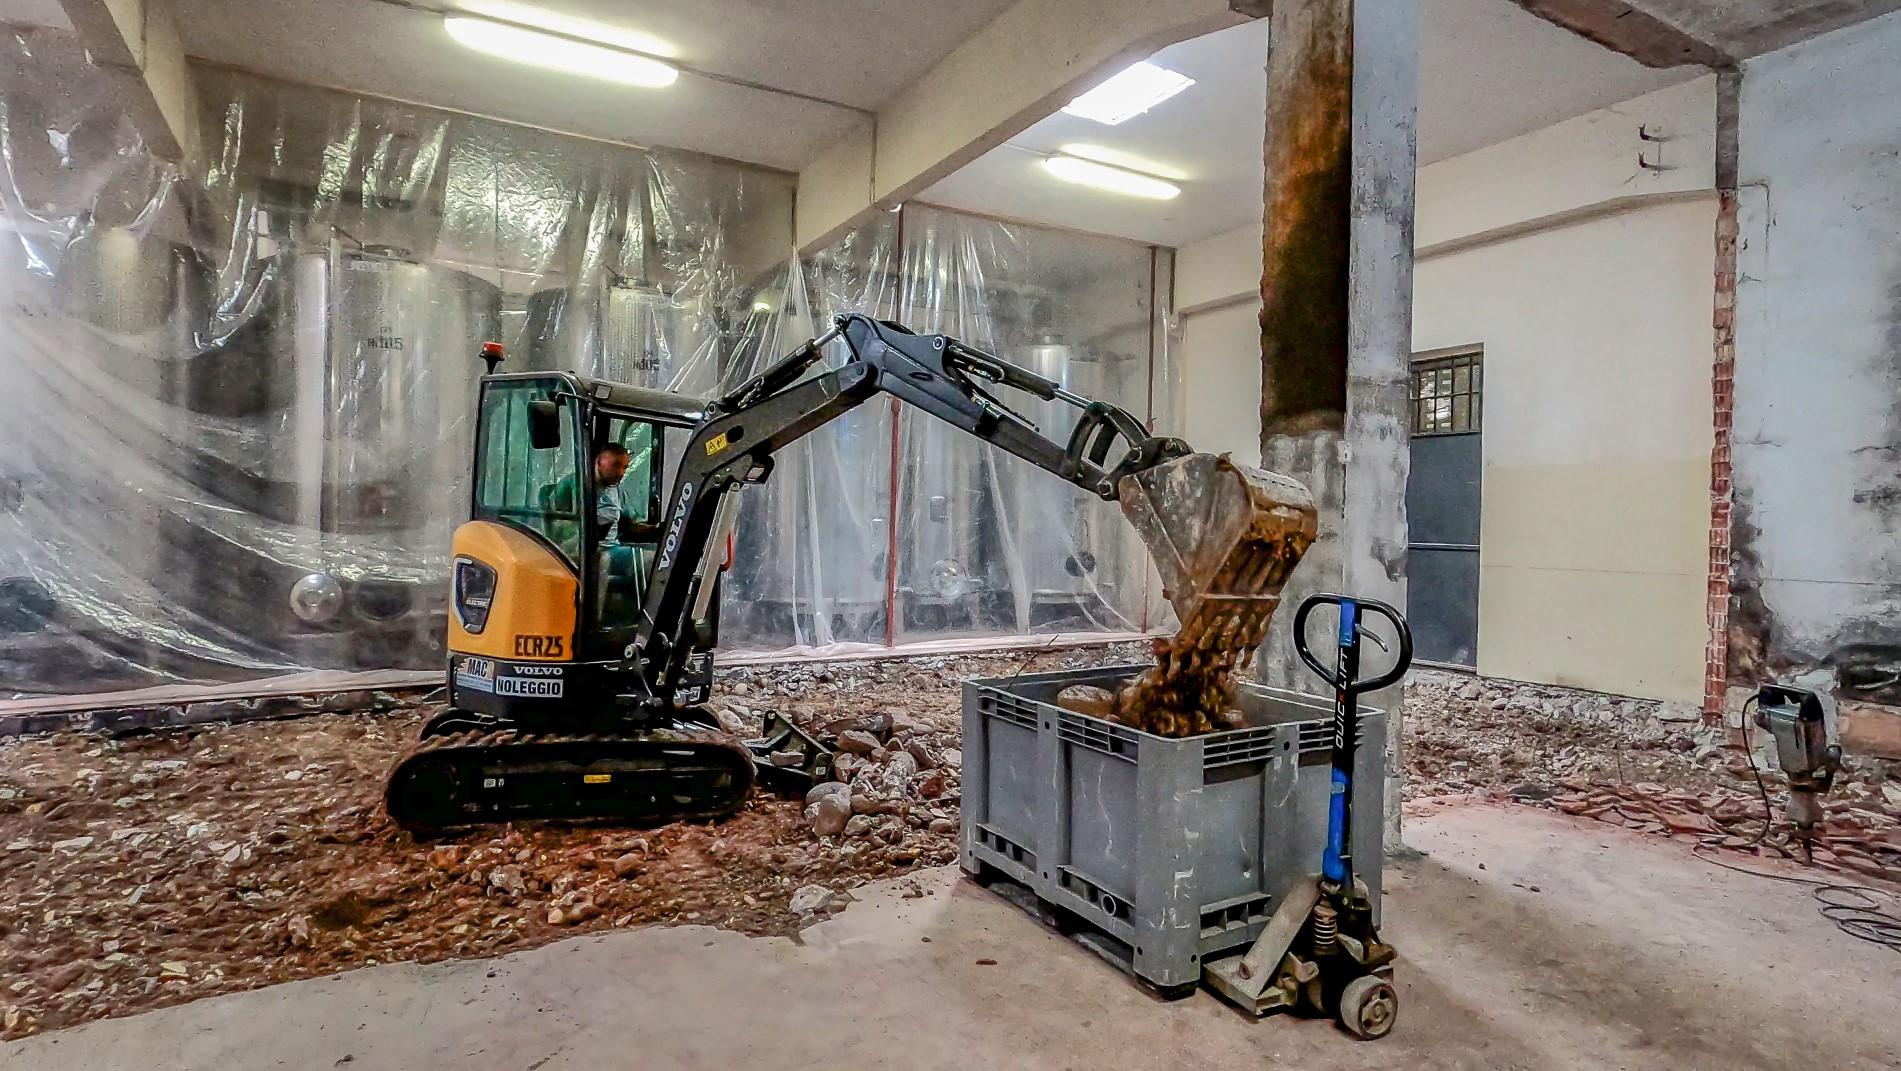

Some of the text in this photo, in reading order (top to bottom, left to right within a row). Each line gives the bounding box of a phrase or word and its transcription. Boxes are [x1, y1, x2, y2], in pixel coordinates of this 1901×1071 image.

[658, 482, 693, 570] VOLVO
[514, 634, 563, 657] ECR25
[467, 658, 488, 678] MAC
[513, 665, 563, 675] VOLVO
[1339, 647, 1348, 690] LIFT
[497, 679, 561, 696] NOLEGGIO
